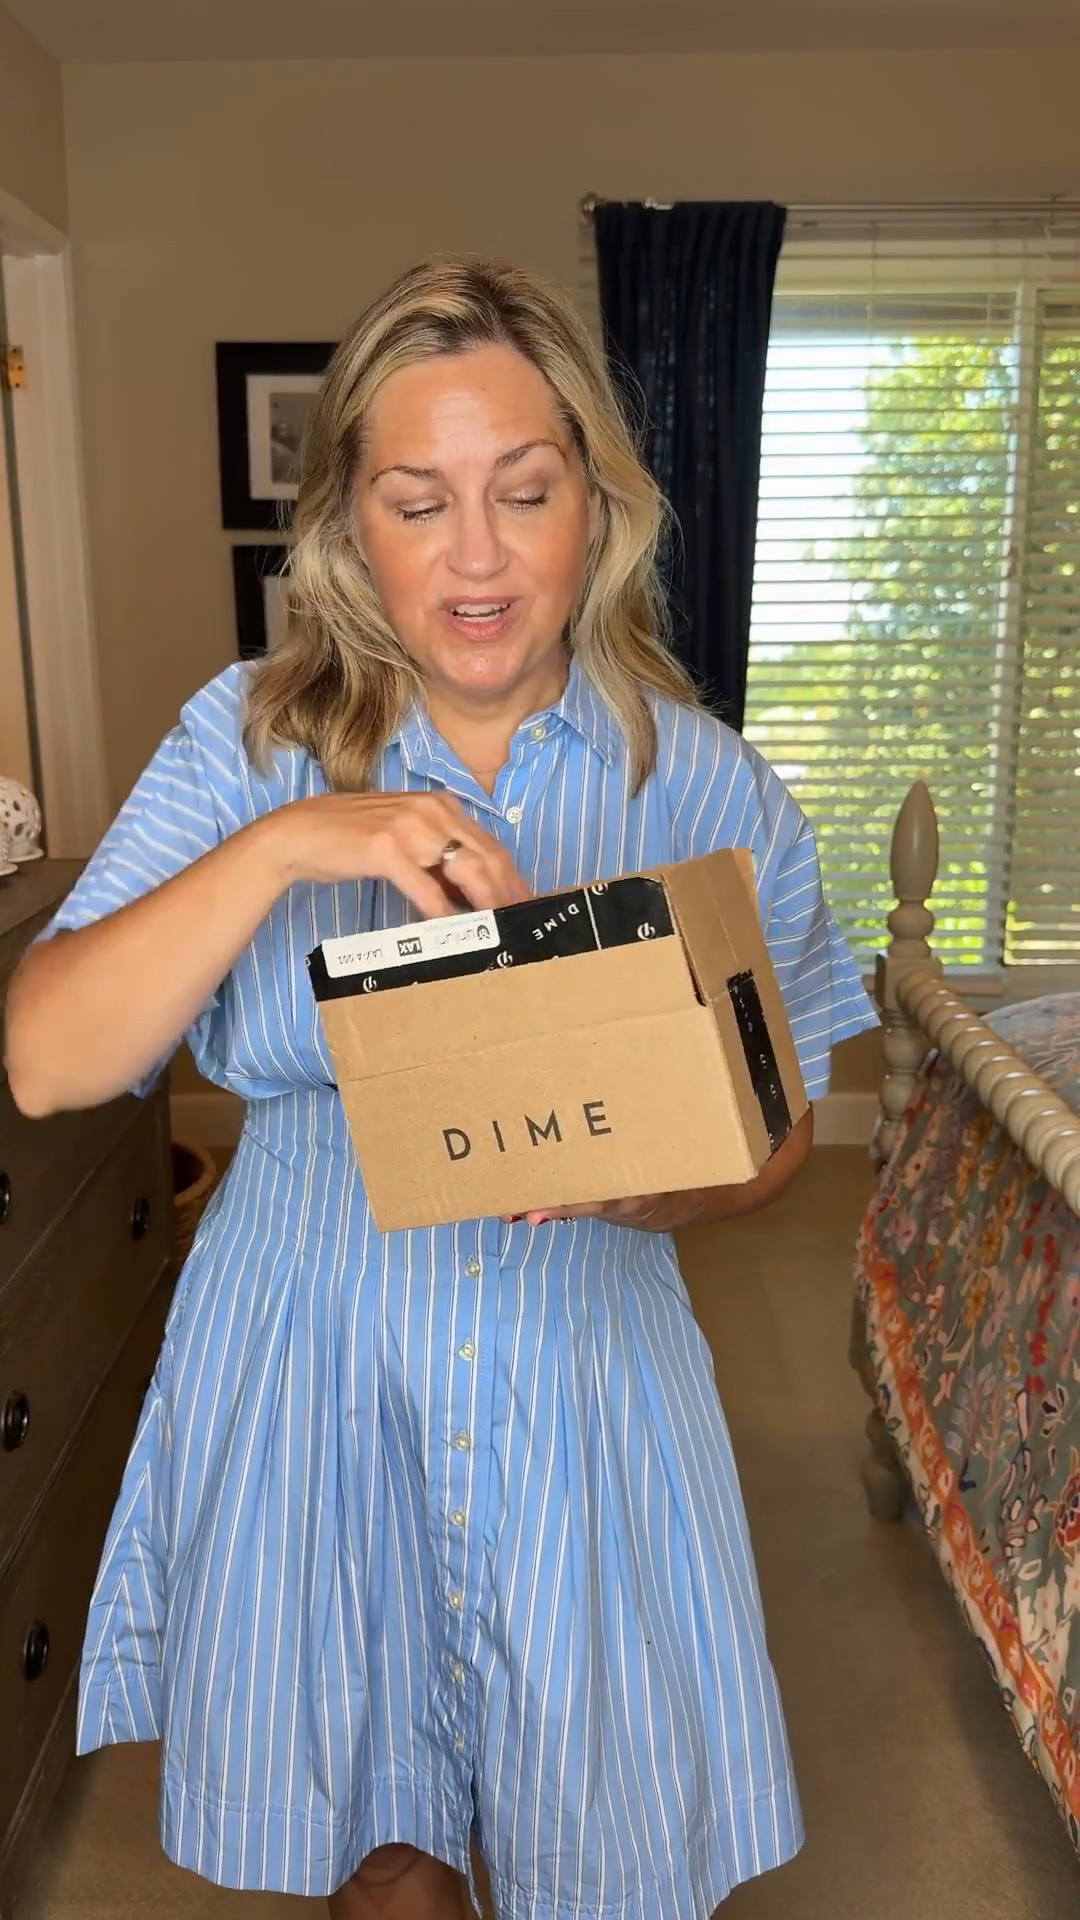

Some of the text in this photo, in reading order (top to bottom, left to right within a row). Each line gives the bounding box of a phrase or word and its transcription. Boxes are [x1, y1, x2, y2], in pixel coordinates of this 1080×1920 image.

[532, 902, 580, 941] DIME
[400, 938, 422, 955] LAX
[442, 1100, 612, 1161] DIME
